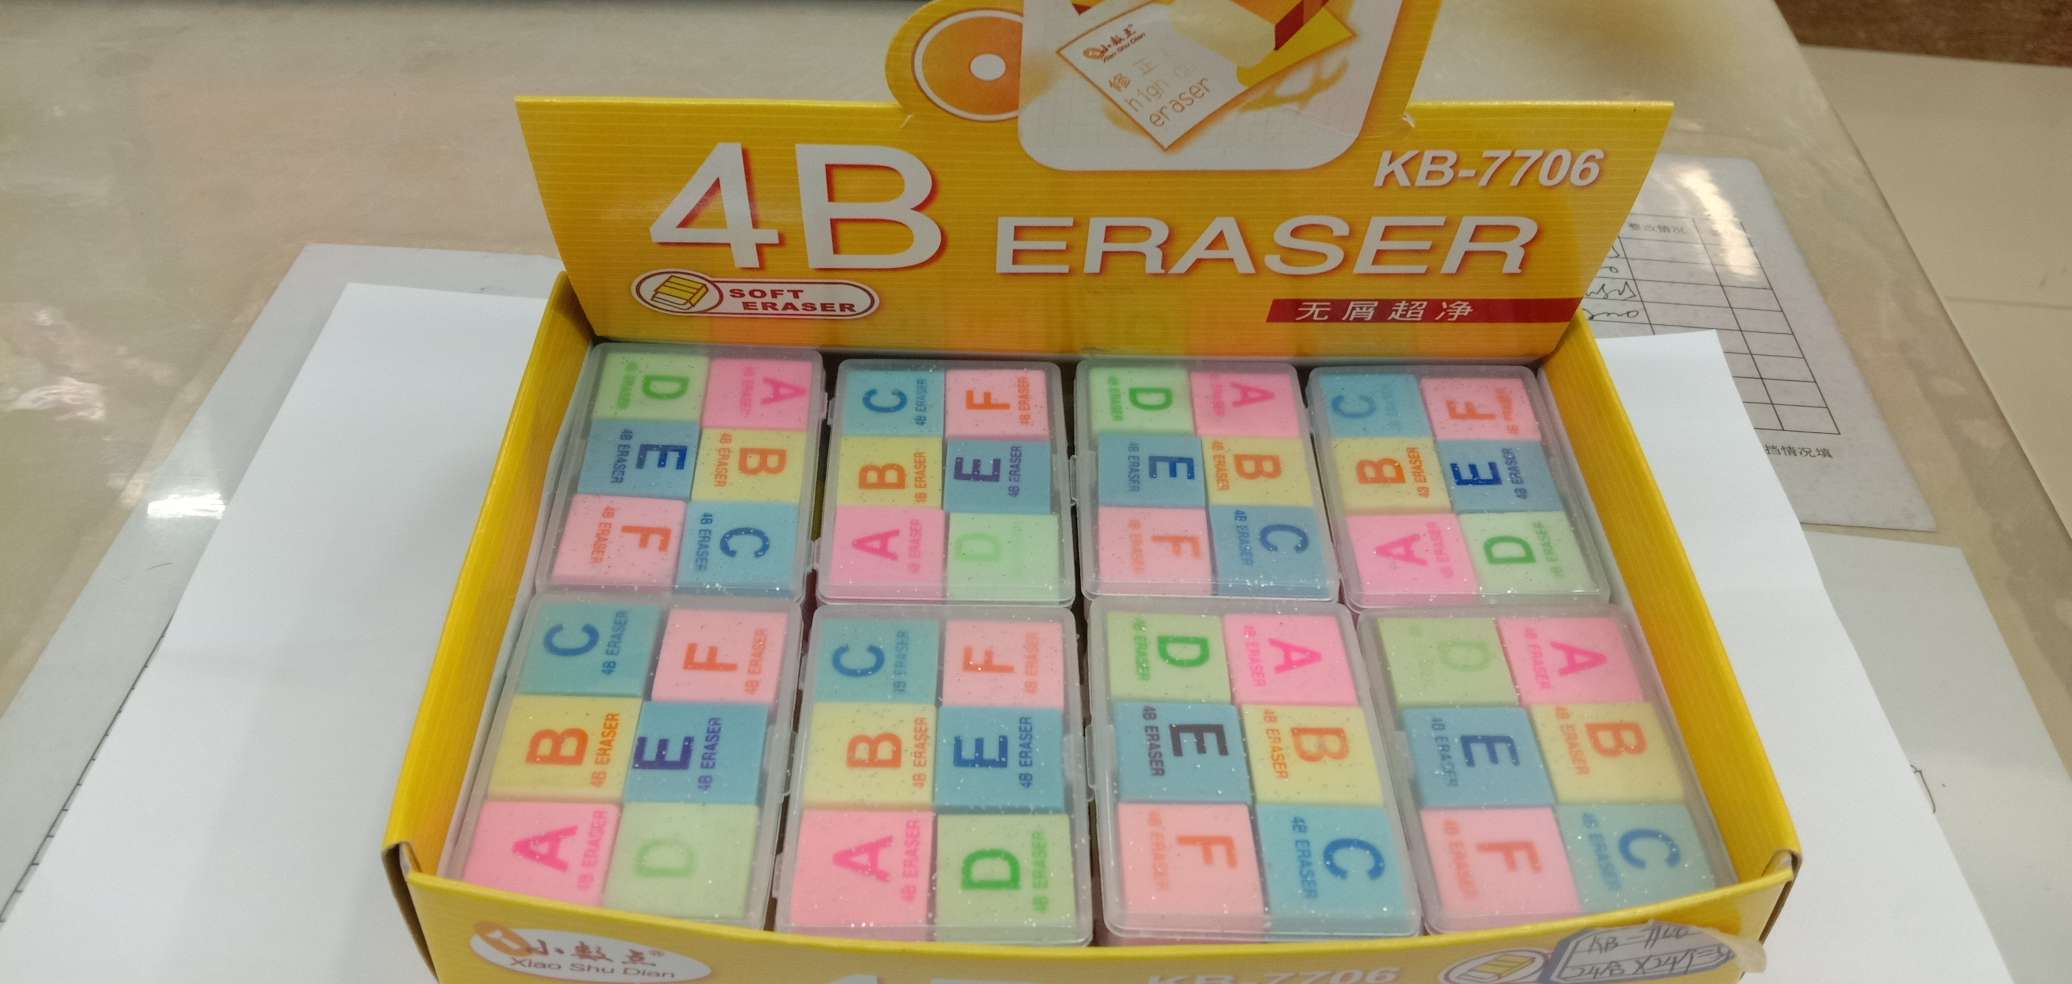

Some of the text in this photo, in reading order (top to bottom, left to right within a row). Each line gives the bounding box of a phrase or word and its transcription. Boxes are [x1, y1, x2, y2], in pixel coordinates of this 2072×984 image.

[1149, 77, 1212, 128] eraser
[1373, 148, 1605, 188] KB-7706
[649, 142, 1540, 276] 4B ERASER
[729, 287, 805, 300] SOFT
[741, 301, 857, 313] ERASER
[1295, 300, 1474, 322] 无屑超净
[642, 374, 690, 400] D
[760, 377, 807, 406] A
[862, 388, 908, 413] C
[965, 389, 1011, 411] F
[1128, 387, 1174, 411] D
[1229, 381, 1276, 407] A
[1331, 394, 1377, 419] C
[1446, 399, 1497, 421] F
[636, 444, 688, 471] E
[738, 447, 788, 476] B
[954, 456, 1002, 483] E
[1148, 454, 1195, 480] E
[1233, 452, 1282, 480] B
[1356, 457, 1406, 484] B
[1450, 461, 1503, 486] E
[858, 463, 907, 490] B
[621, 525, 672, 553] F
[719, 527, 771, 558] C
[852, 528, 901, 561] A
[1152, 535, 1203, 560] F
[1259, 523, 1310, 554] C
[1374, 533, 1428, 566] A
[1484, 535, 1537, 565] D
[543, 622, 600, 656] C
[1157, 635, 1210, 668] D
[1268, 637, 1323, 674] A
[682, 642, 739, 671] F
[832, 644, 886, 678] C
[962, 645, 1015, 673] F
[1550, 640, 1608, 677] A
[526, 726, 590, 766] B
[632, 735, 695, 770] E
[700, 716, 723, 769] ERASER
[846, 732, 903, 768] B
[912, 715, 928, 768] ERASER
[953, 735, 1009, 768] E
[1018, 715, 1034, 789] 4B ERASER
[1142, 705, 1166, 777] 4B ERASER
[1168, 723, 1230, 757] E
[1265, 727, 1290, 780] ERASER
[1291, 726, 1351, 763] B
[1460, 734, 1521, 768] E
[1584, 721, 1649, 759] B
[511, 825, 578, 873] A
[635, 837, 696, 878] D
[831, 834, 894, 883] A
[1175, 834, 1238, 869] F
[1322, 837, 1386, 881] C
[1475, 839, 1543, 874] F
[1618, 827, 1682, 869] C
[960, 847, 1022, 890] D
[509, 957, 676, 979] Xiao Shu Dian
